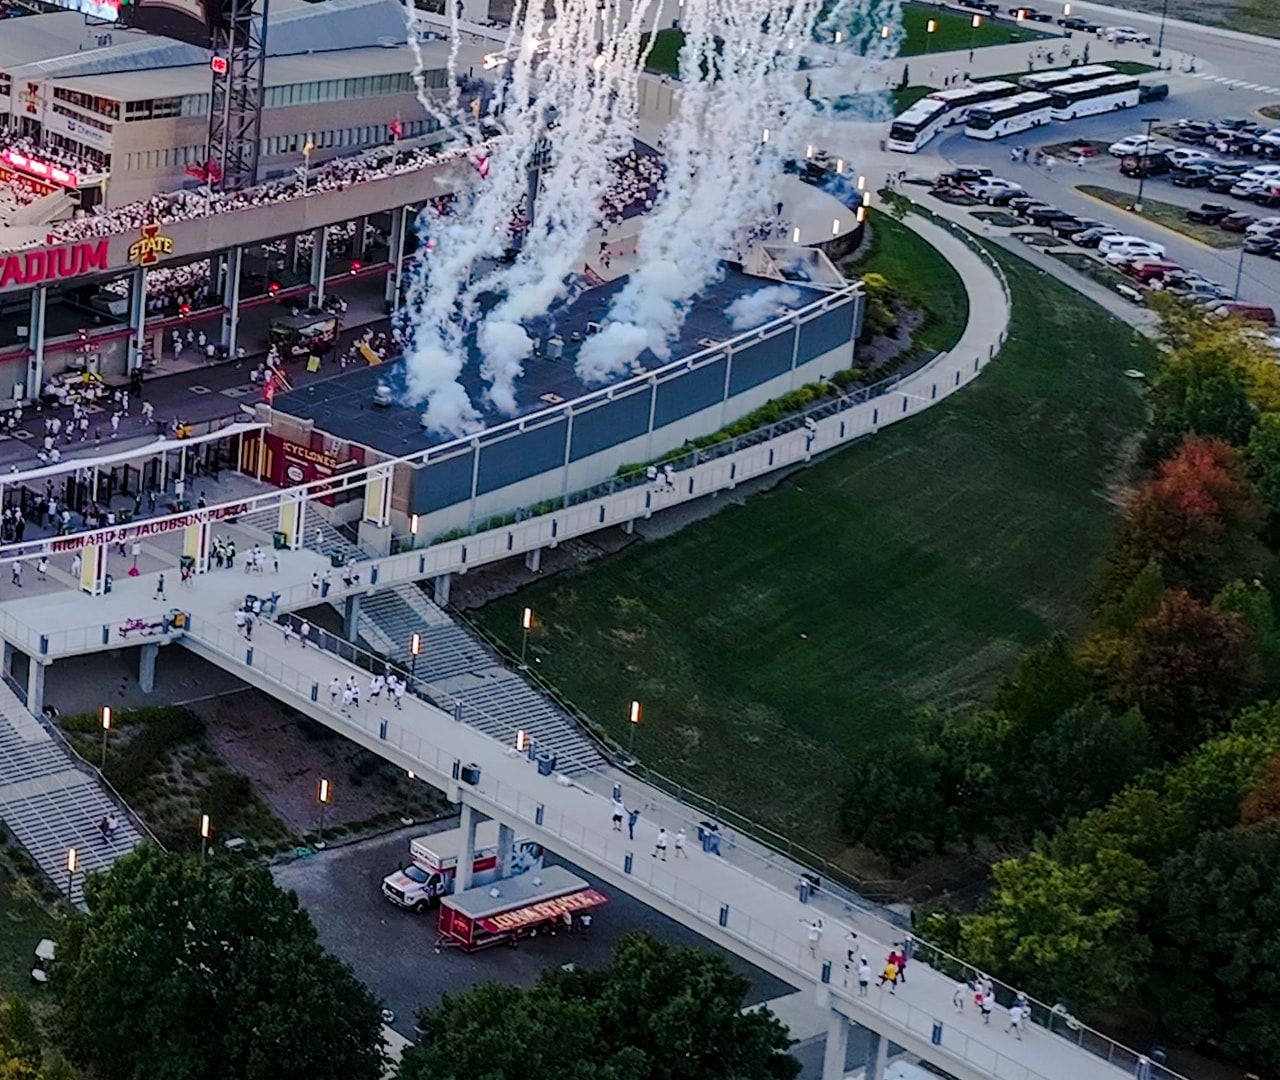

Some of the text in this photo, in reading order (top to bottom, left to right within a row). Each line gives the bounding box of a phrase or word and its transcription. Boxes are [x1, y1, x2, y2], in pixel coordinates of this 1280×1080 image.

[128, 236, 174, 261] STATE
[283, 442, 337, 469] CYCLONES
[52, 530, 116, 553] RICHARD
[136, 514, 203, 537] JACOBSON
[488, 907, 542, 928] IOWA
